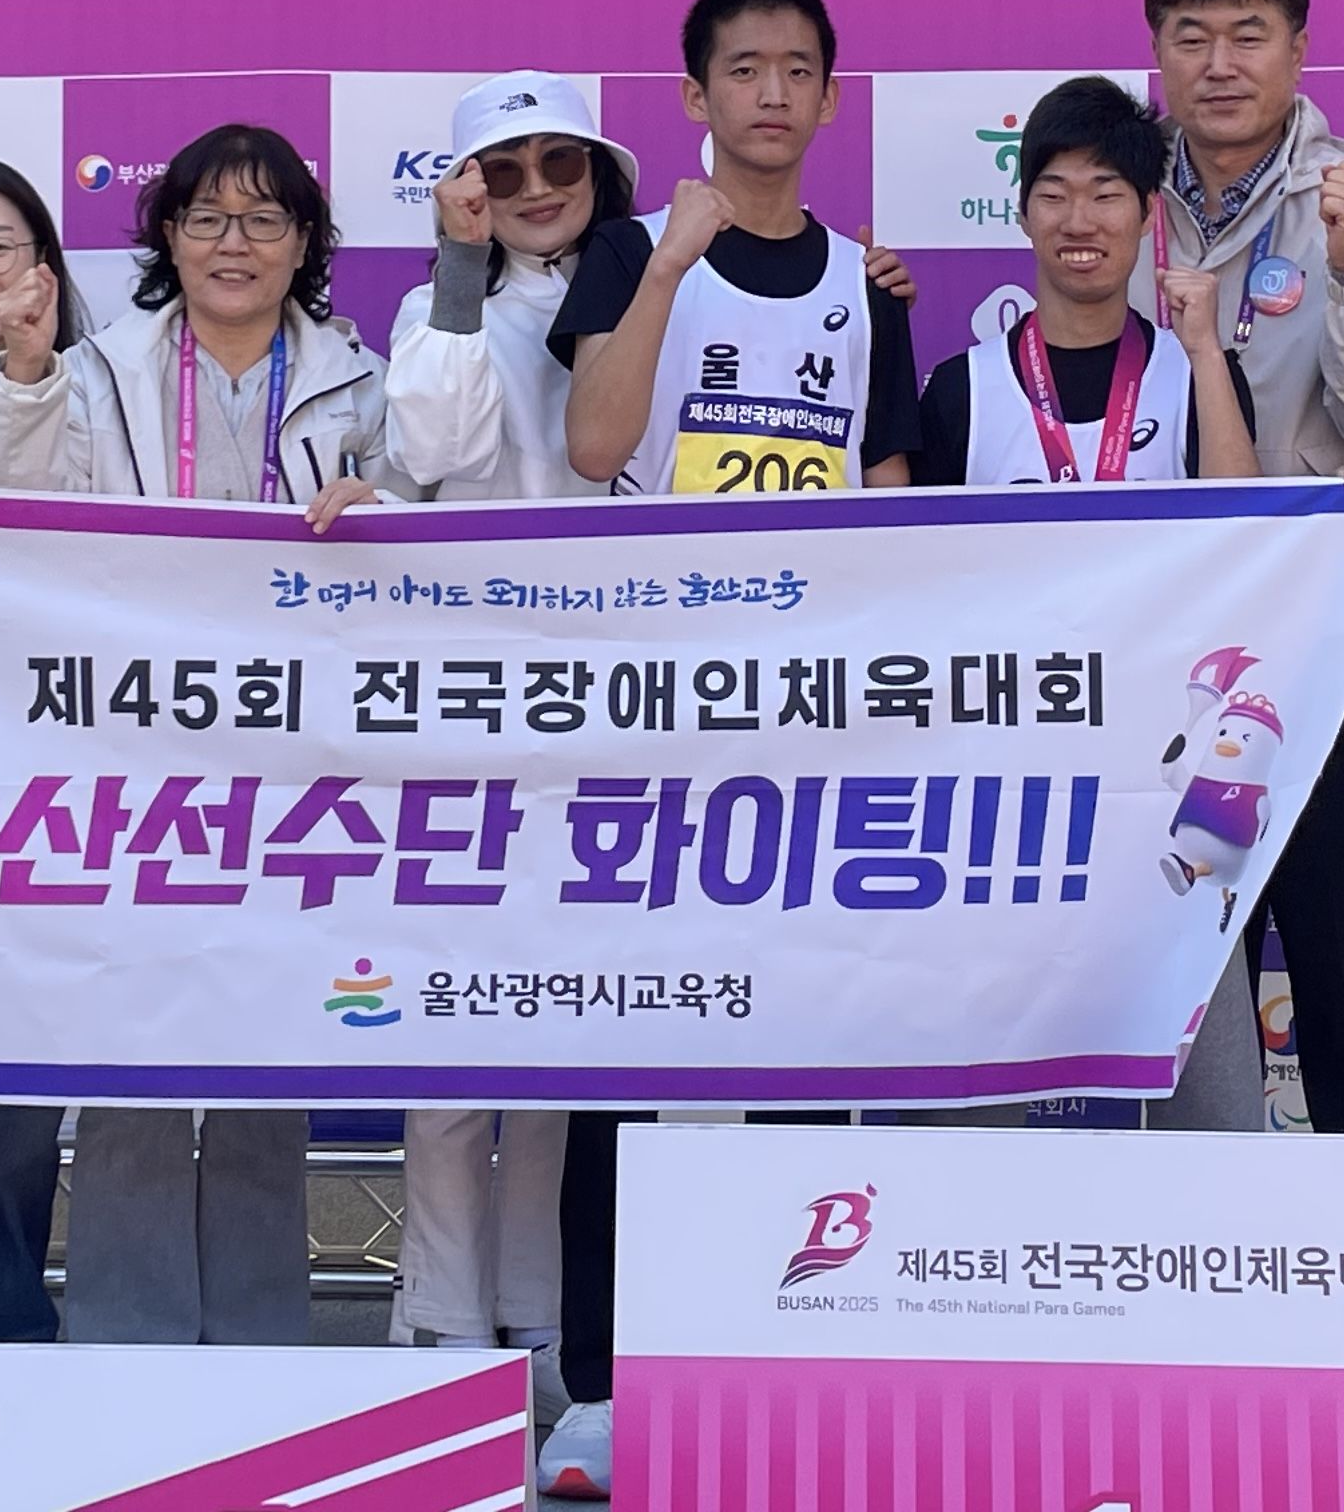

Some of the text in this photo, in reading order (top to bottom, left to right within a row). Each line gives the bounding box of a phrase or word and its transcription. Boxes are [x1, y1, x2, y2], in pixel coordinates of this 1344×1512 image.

[270, 568, 809, 612] 한 명의 아이도 포기하지 않는 울산교육
[27, 651, 1104, 734] 제45회 전국장애인체육대회
[559, 773, 1101, 912] 화이팅!!!
[419, 971, 754, 1020] 울산광역시교육청
[896, 1248, 1008, 1285] 제45회
[776, 1295, 879, 1313] BUSAN 2025
[896, 1297, 1126, 1317] The 45th National Para Games
